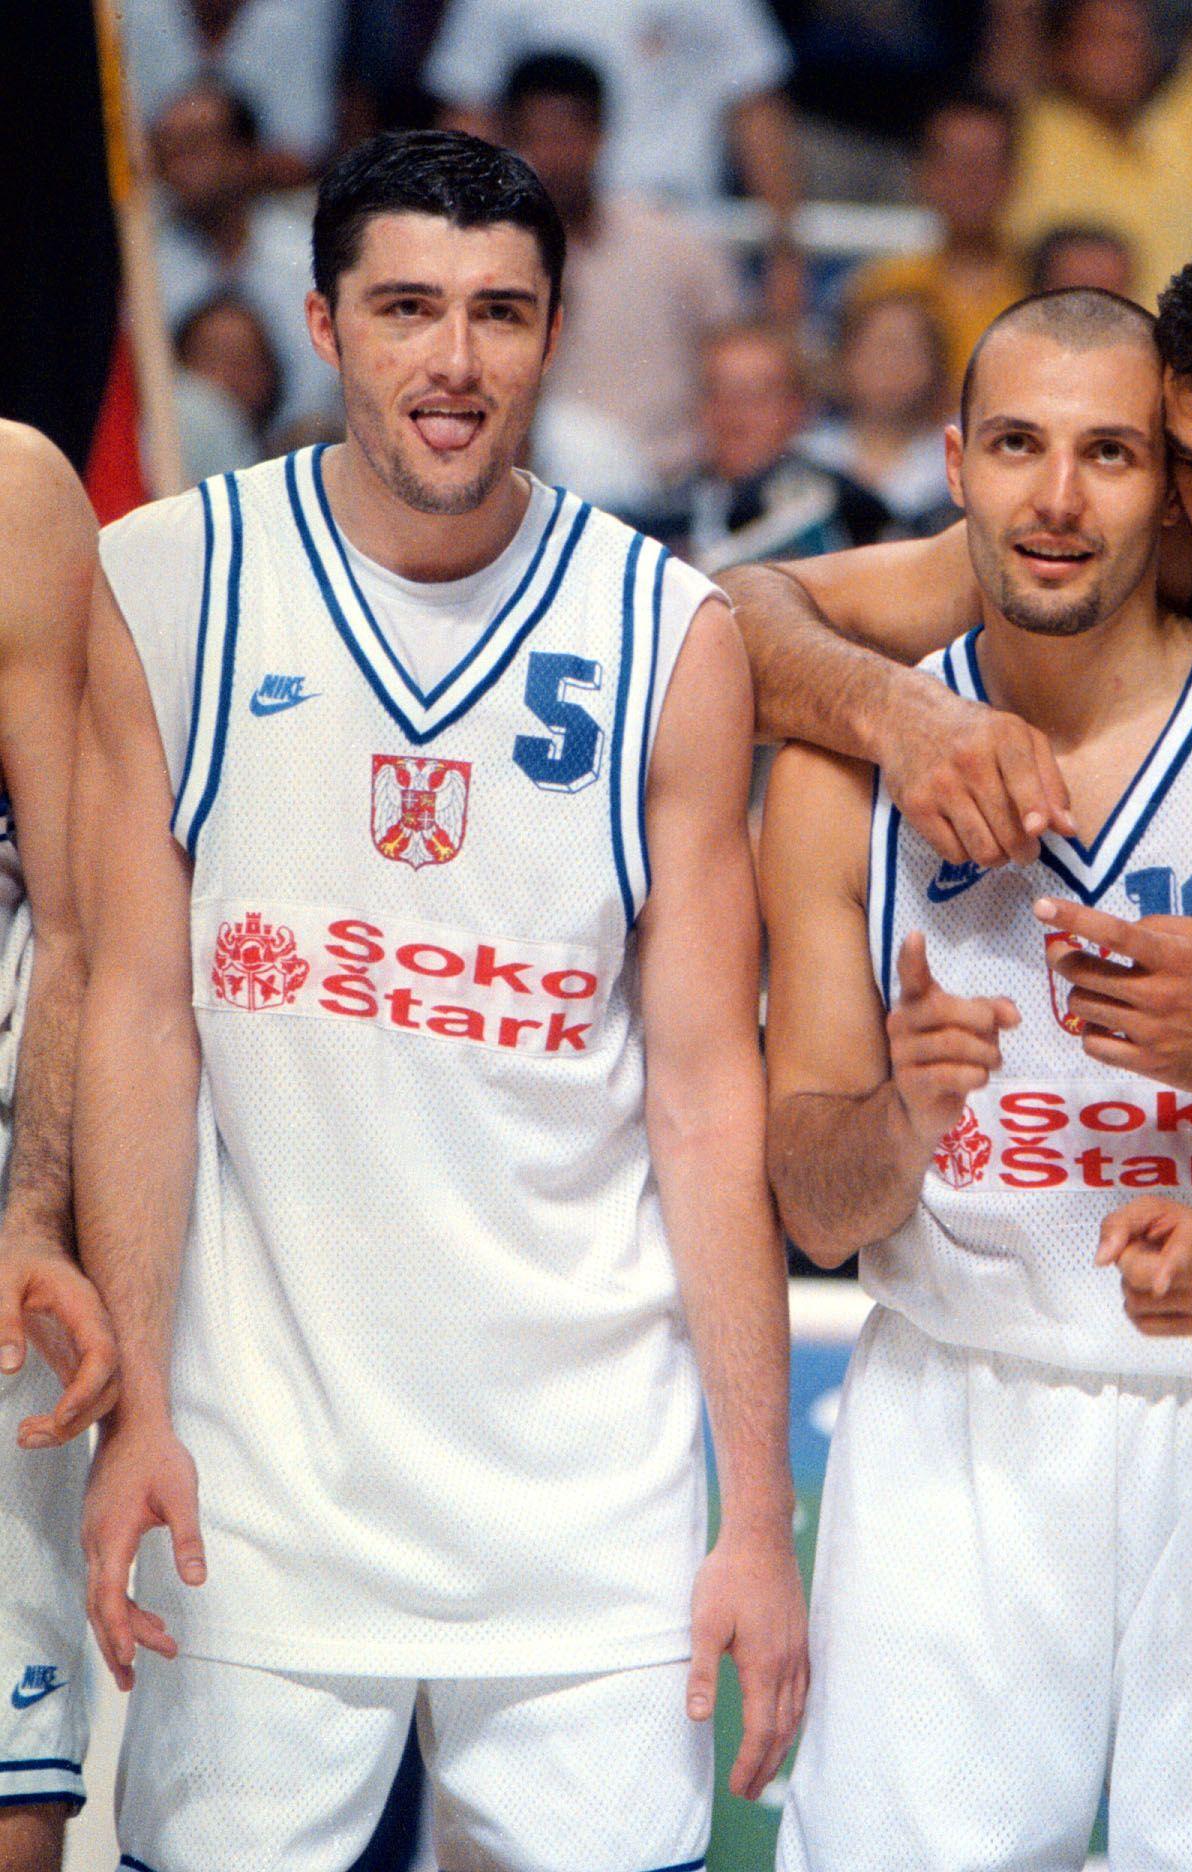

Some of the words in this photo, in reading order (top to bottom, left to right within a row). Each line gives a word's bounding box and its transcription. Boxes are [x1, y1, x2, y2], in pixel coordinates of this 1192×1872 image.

[259, 674, 306, 700] NIKE
[512, 651, 603, 793] 5
[324, 919, 598, 1001] Soko
[319, 963, 593, 1053] Štark
